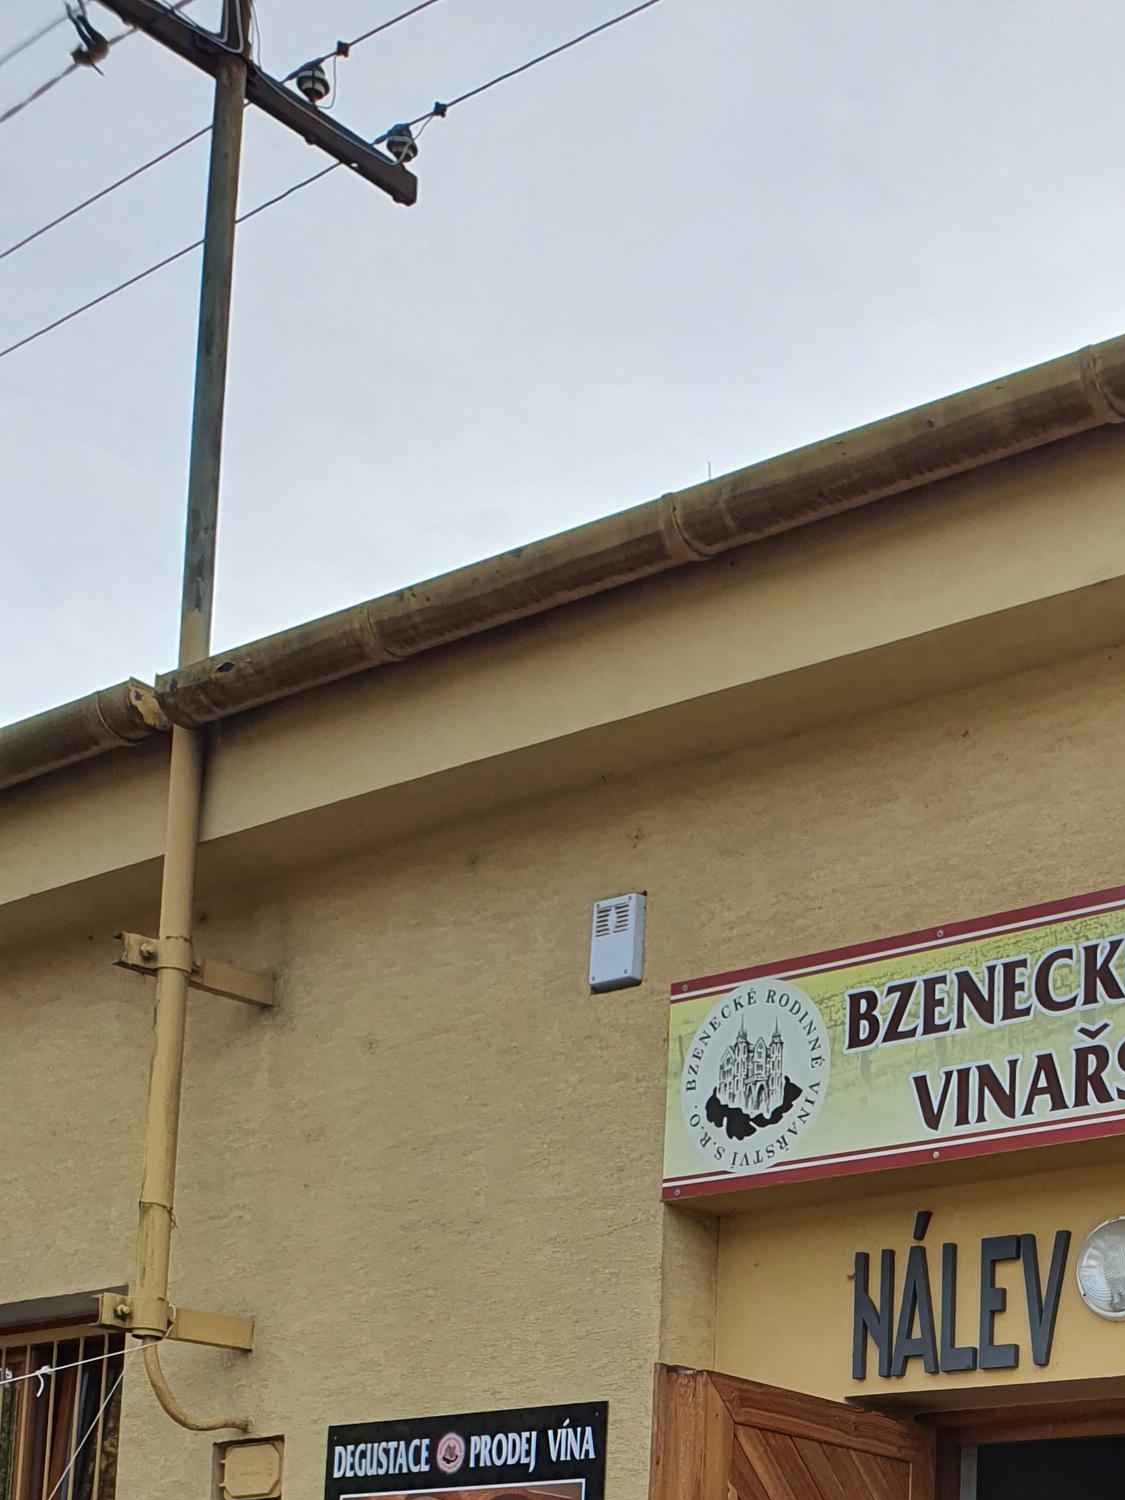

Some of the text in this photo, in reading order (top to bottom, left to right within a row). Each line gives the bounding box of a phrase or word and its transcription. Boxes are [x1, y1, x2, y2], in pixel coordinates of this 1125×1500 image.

[686, 987, 757, 1092] BZENECKÉ
[765, 989, 826, 1068] RODINNÉ
[731, 1081, 821, 1169] VINAŘSTVÍ
[852, 1211, 1071, 1380] NÁLEV
[333, 1419, 595, 1479] DEGUSTACE PRODEJ VÍNA
